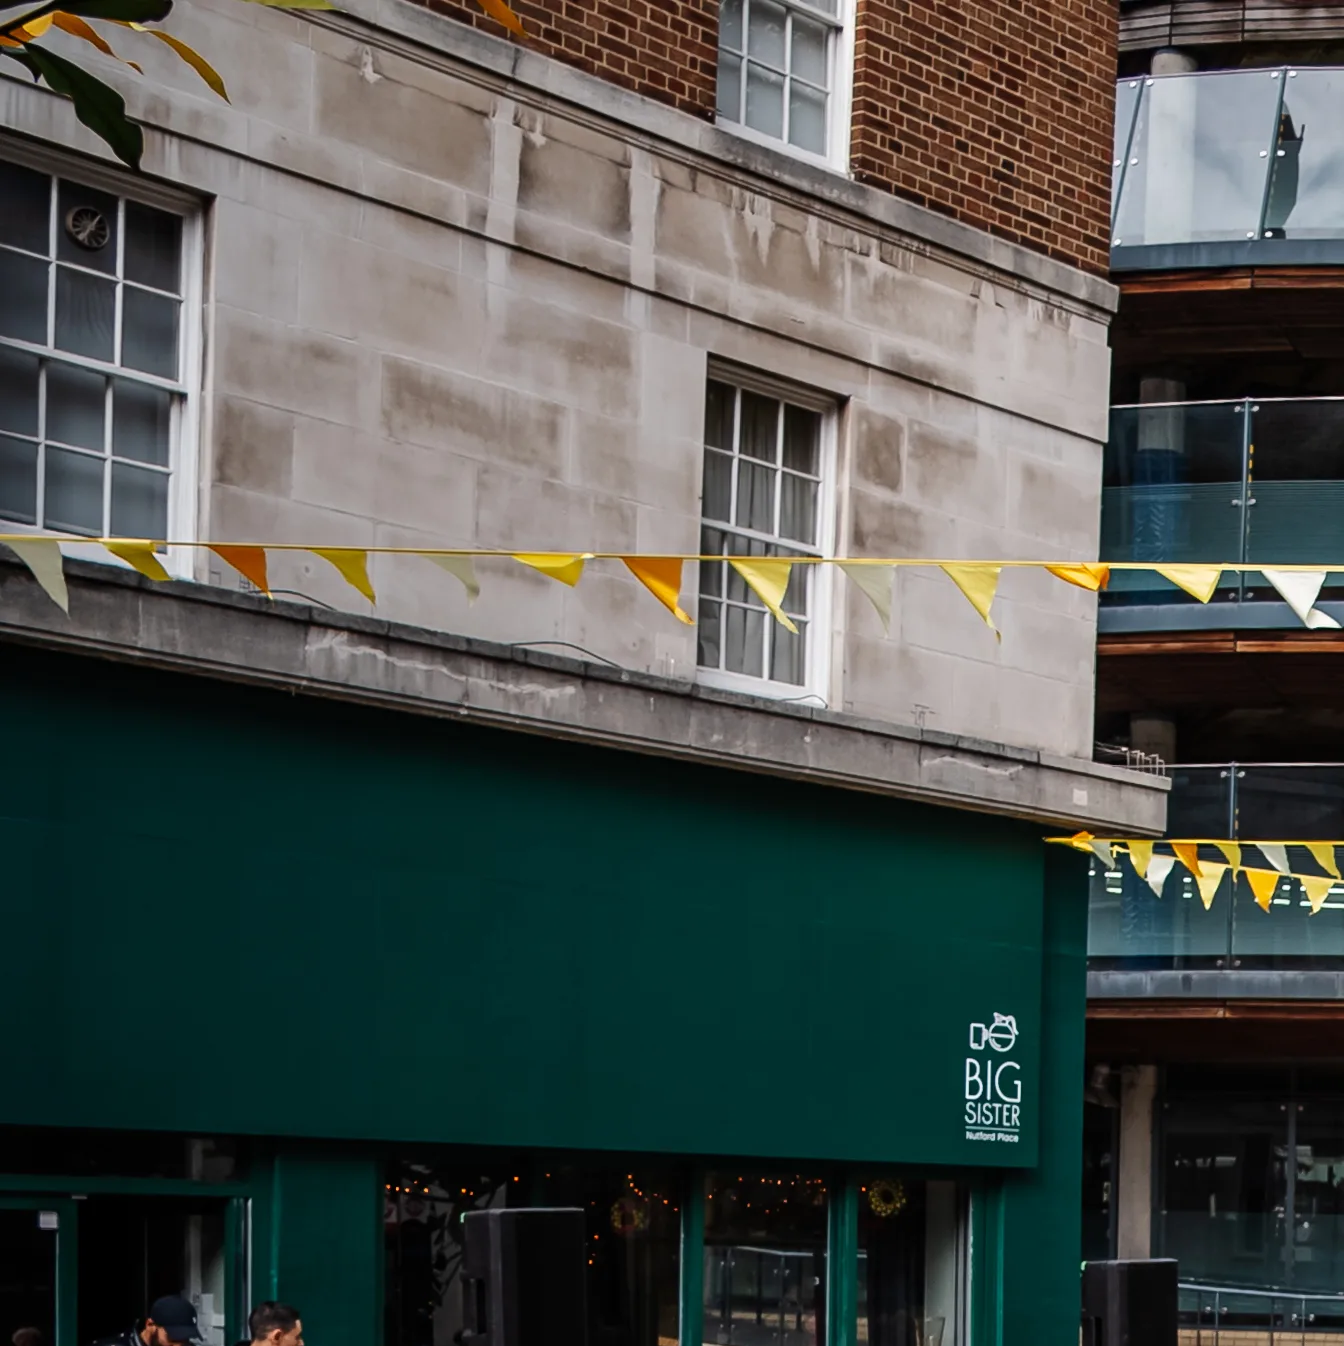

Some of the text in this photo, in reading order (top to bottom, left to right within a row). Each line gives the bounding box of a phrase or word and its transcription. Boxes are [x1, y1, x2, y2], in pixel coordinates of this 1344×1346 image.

[965, 1058, 1022, 1103] BIG
[964, 1102, 1021, 1127] SISTER
[966, 1131, 1020, 1143] Nutford Place
